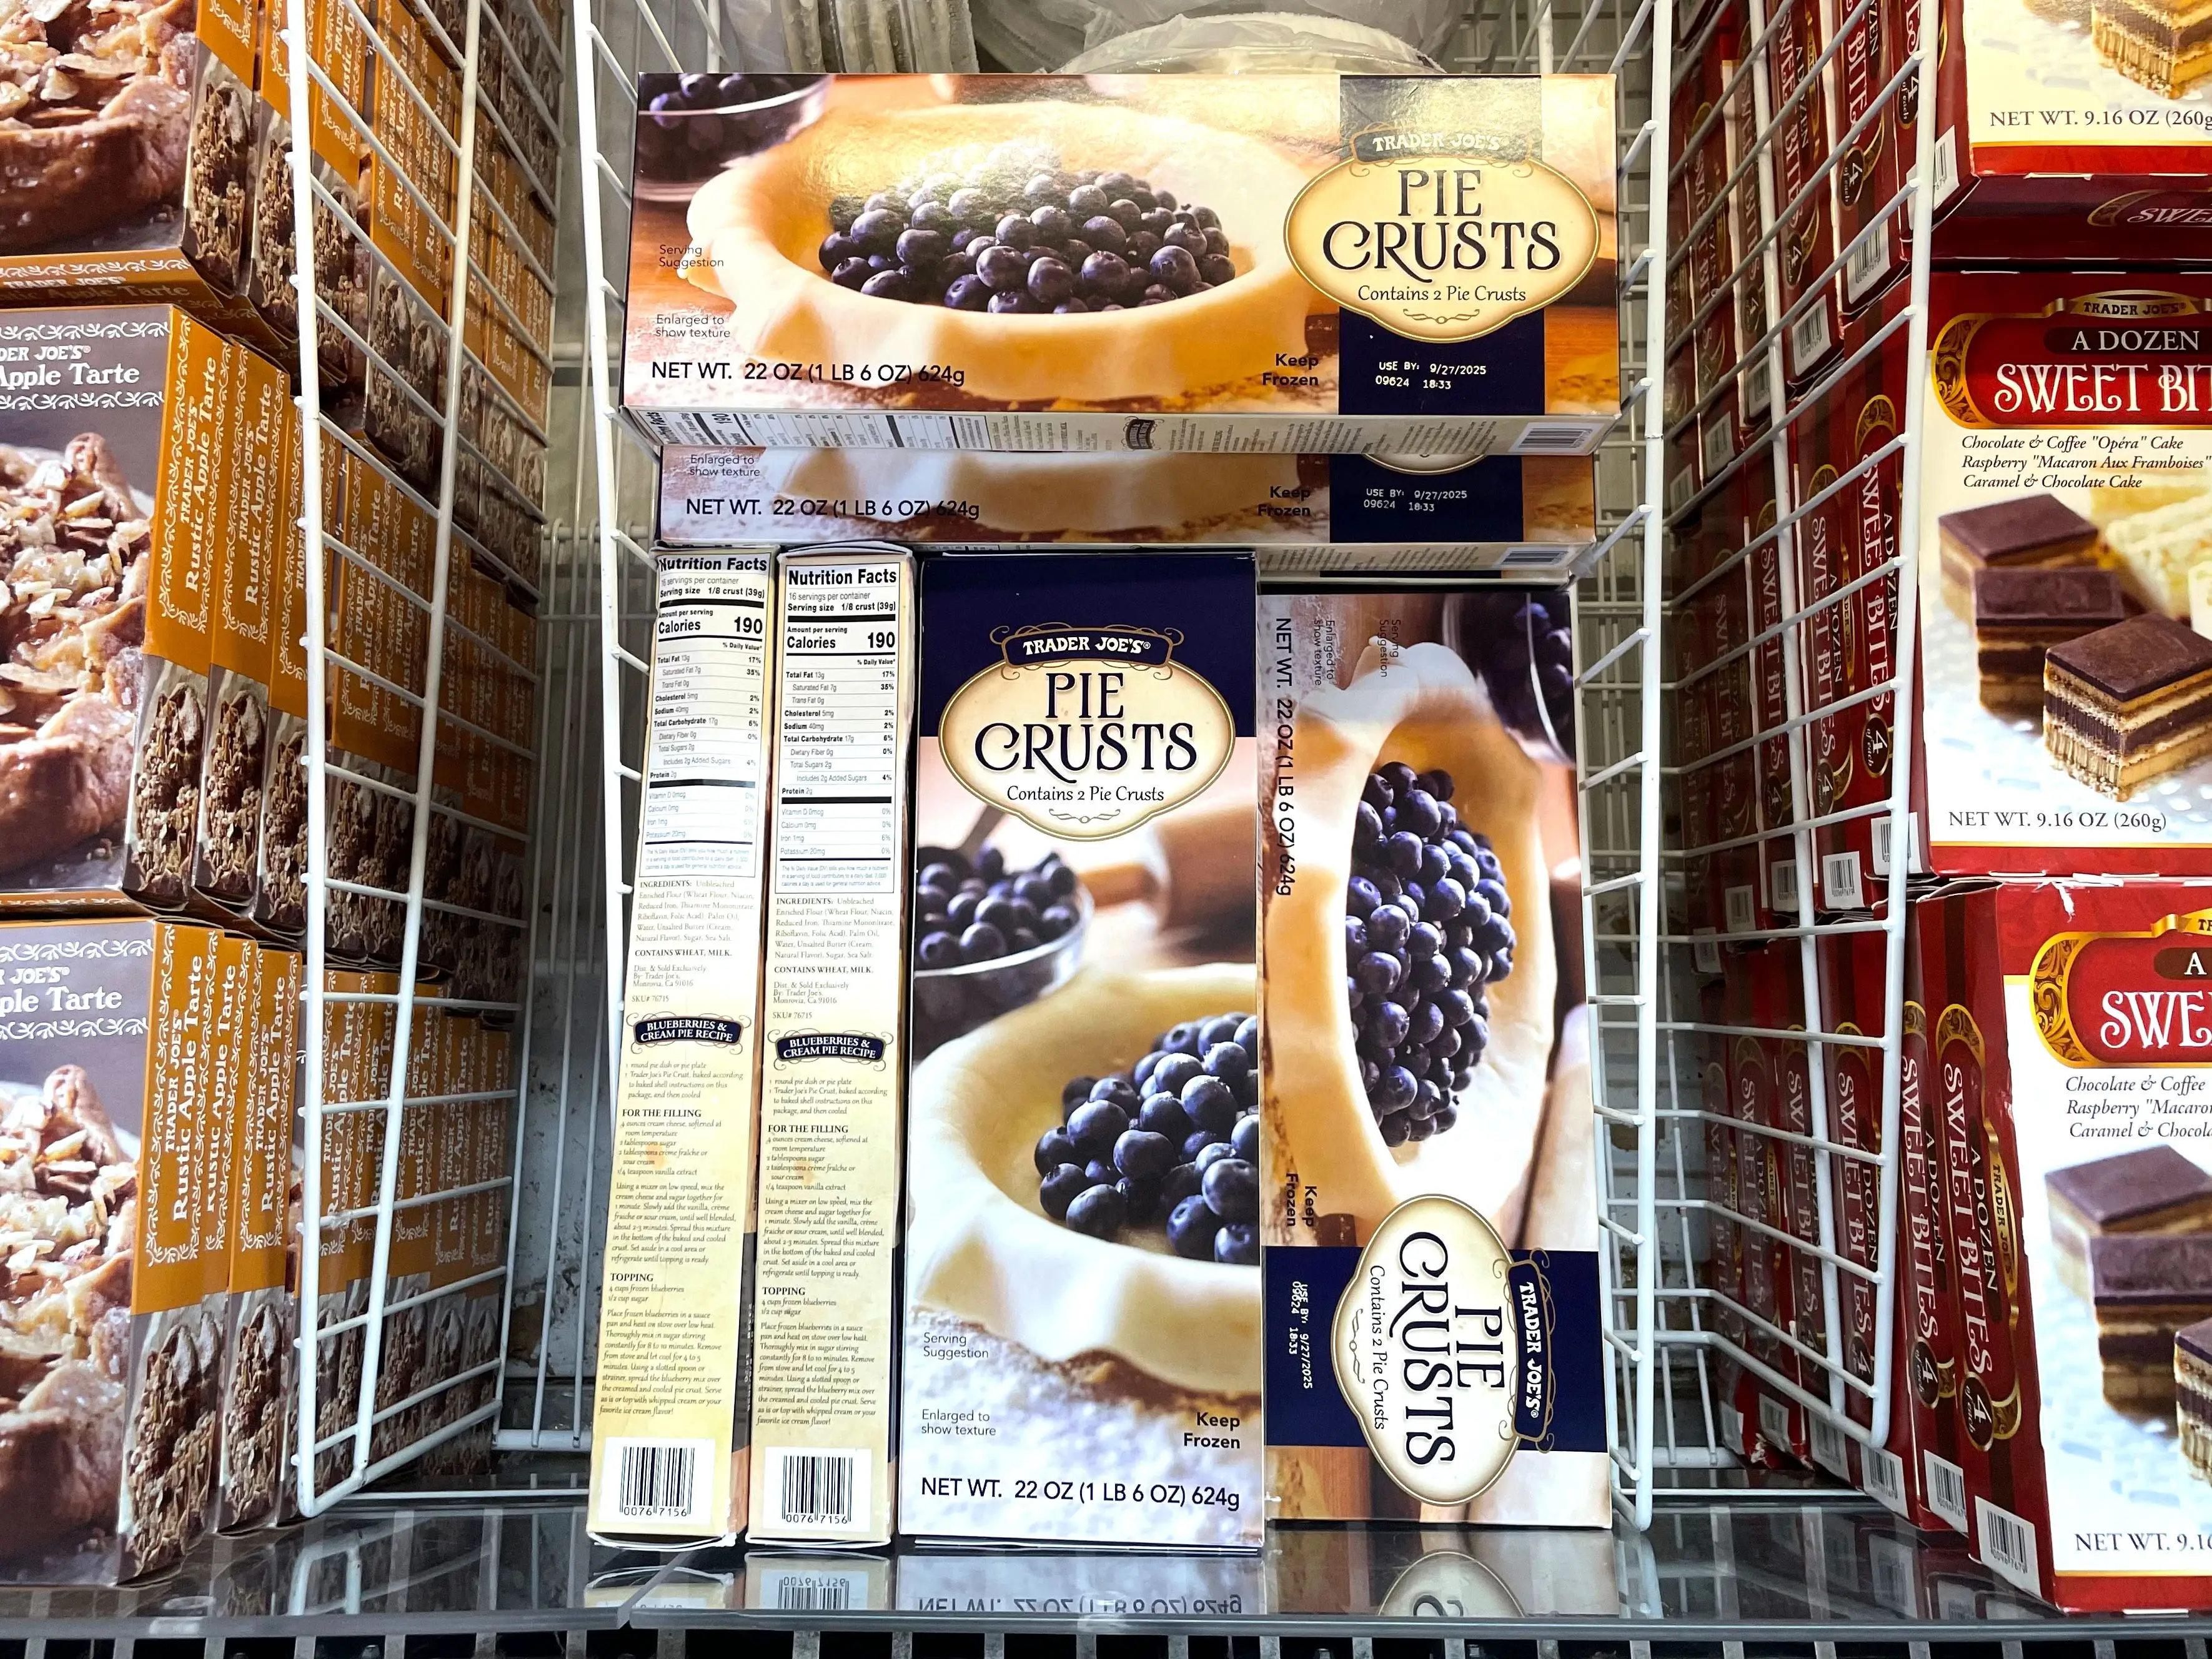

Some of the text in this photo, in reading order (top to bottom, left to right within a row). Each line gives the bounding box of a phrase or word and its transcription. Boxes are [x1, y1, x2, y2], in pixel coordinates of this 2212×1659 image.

[1990, 111, 2034, 126] NET
[2039, 110, 2078, 125] WT.
[2085, 110, 2122, 126] 9.16
[2129, 110, 2159, 124] OZ
[1373, 132, 1444, 151] TRADER
[1398, 169, 1481, 217] PIE
[660, 245, 702, 257] Serving
[1322, 221, 1560, 283] CRUSTS
[658, 257, 724, 269] Suggestion
[1358, 286, 1526, 302] Contains 2 Pie Crusts
[2083, 302, 2138, 315] TRADER
[656, 315, 724, 327] Enlarged to
[655, 327, 730, 338] show texture
[2071, 330, 2200, 350] A DOZEN
[1275, 354, 1319, 372] Keep
[1379, 361, 1486, 375] USE BY: 9/27/2025
[68, 362, 139, 385] Tarte
[652, 361, 965, 387] NET WT. 22 OZ (1 LB 6 OZ) 624g
[1262, 372, 1319, 387] Frozen
[1376, 375, 1451, 390] 09624 18:33
[1995, 364, 2148, 413] SWEET
[1962, 436, 2025, 449] Chocolate
[2029, 436, 2043, 448] &
[2047, 436, 2086, 452] Coffee
[2151, 436, 2183, 449] Cake
[1962, 455, 2027, 472] Raspberry
[2033, 455, 2097, 468] "Macaron
[2101, 455, 2128, 468] Aux
[186, 356, 216, 592] Rustic Apple Tarte
[1963, 475, 2142, 488] Caramel & Chocolate Cake
[181, 456, 194, 524] TRADER
[1270, 486, 1311, 502] Keep
[1366, 488, 1384, 497] USE
[1414, 490, 1467, 500] 9/27/2025
[1258, 504, 1311, 517] Frozen
[1364, 499, 1396, 509] 09624
[660, 557, 767, 572] Nutrition Facts
[788, 568, 896, 585] Nutrition Facts
[798, 592, 825, 602] servings
[827, 593, 838, 601] per
[840, 592, 870, 600] container
[788, 603, 817, 613] Serving
[877, 602, 896, 611] (39g)
[658, 617, 763, 633] Calories 190
[787, 633, 895, 648] Calories 190
[1023, 637, 1089, 655] TRADER
[1377, 620, 1389, 677] Suggestion
[1324, 620, 1335, 680] Enlarged to
[1046, 672, 1124, 719] PIE
[975, 723, 1197, 784] CRUSTS
[1007, 786, 1164, 801] Contains 2 Pie Crusts
[1949, 812, 2166, 832] NET WT. 9.16 OZ (260g)
[45, 986, 122, 1011] Tarte
[790, 1038, 860, 1048] BLUEBERRIES
[783, 1046, 876, 1058] CREAM PIE RECIPE
[173, 956, 202, 1220] Rustic Apple Tarte
[2066, 1076, 2206, 1095] Chocolate & Coffee
[2066, 1100, 2139, 1119] Raspberry
[2070, 1122, 2133, 1137] Caramel
[1286, 1173, 1298, 1227] Frozen
[1993, 1164, 2005, 1227] TRADER
[1303, 1186, 1317, 1227] Keep
[1944, 1063, 1992, 1374] SWEET BITES
[1972, 1148, 1998, 1292] A DOZEN
[610, 1273, 653, 1282] TOPPING
[762, 1287, 806, 1295] TOPPING
[1369, 1264, 1384, 1335] Contains
[1519, 1282, 1542, 1354] TRADER
[924, 1333, 966, 1346] Serving
[1389, 1231, 1456, 1465] CRUSTS
[1454, 1305, 1505, 1388] PIE
[923, 1347, 989, 1360] Suggestion
[1300, 1334, 1312, 1389] 9/27/2025
[1373, 1352, 1387, 1374] Pie
[1374, 1379, 1388, 1429] Crusts
[1975, 1394, 1991, 1423] 4
[922, 1410, 989, 1424] Enlarged to
[1196, 1413, 1240, 1430] Keep
[921, 1424, 996, 1435] show texture
[1184, 1434, 1240, 1449] Frozen
[922, 1478, 1239, 1510] NET WT. 22 OZ (1 LB 6 OZ) 624g
[623, 1507, 687, 1517] 0076 7156
[786, 1515, 848, 1524] 0076 7156
[2075, 1533, 2121, 1551] NET
[2127, 1533, 2170, 1550] WT.
